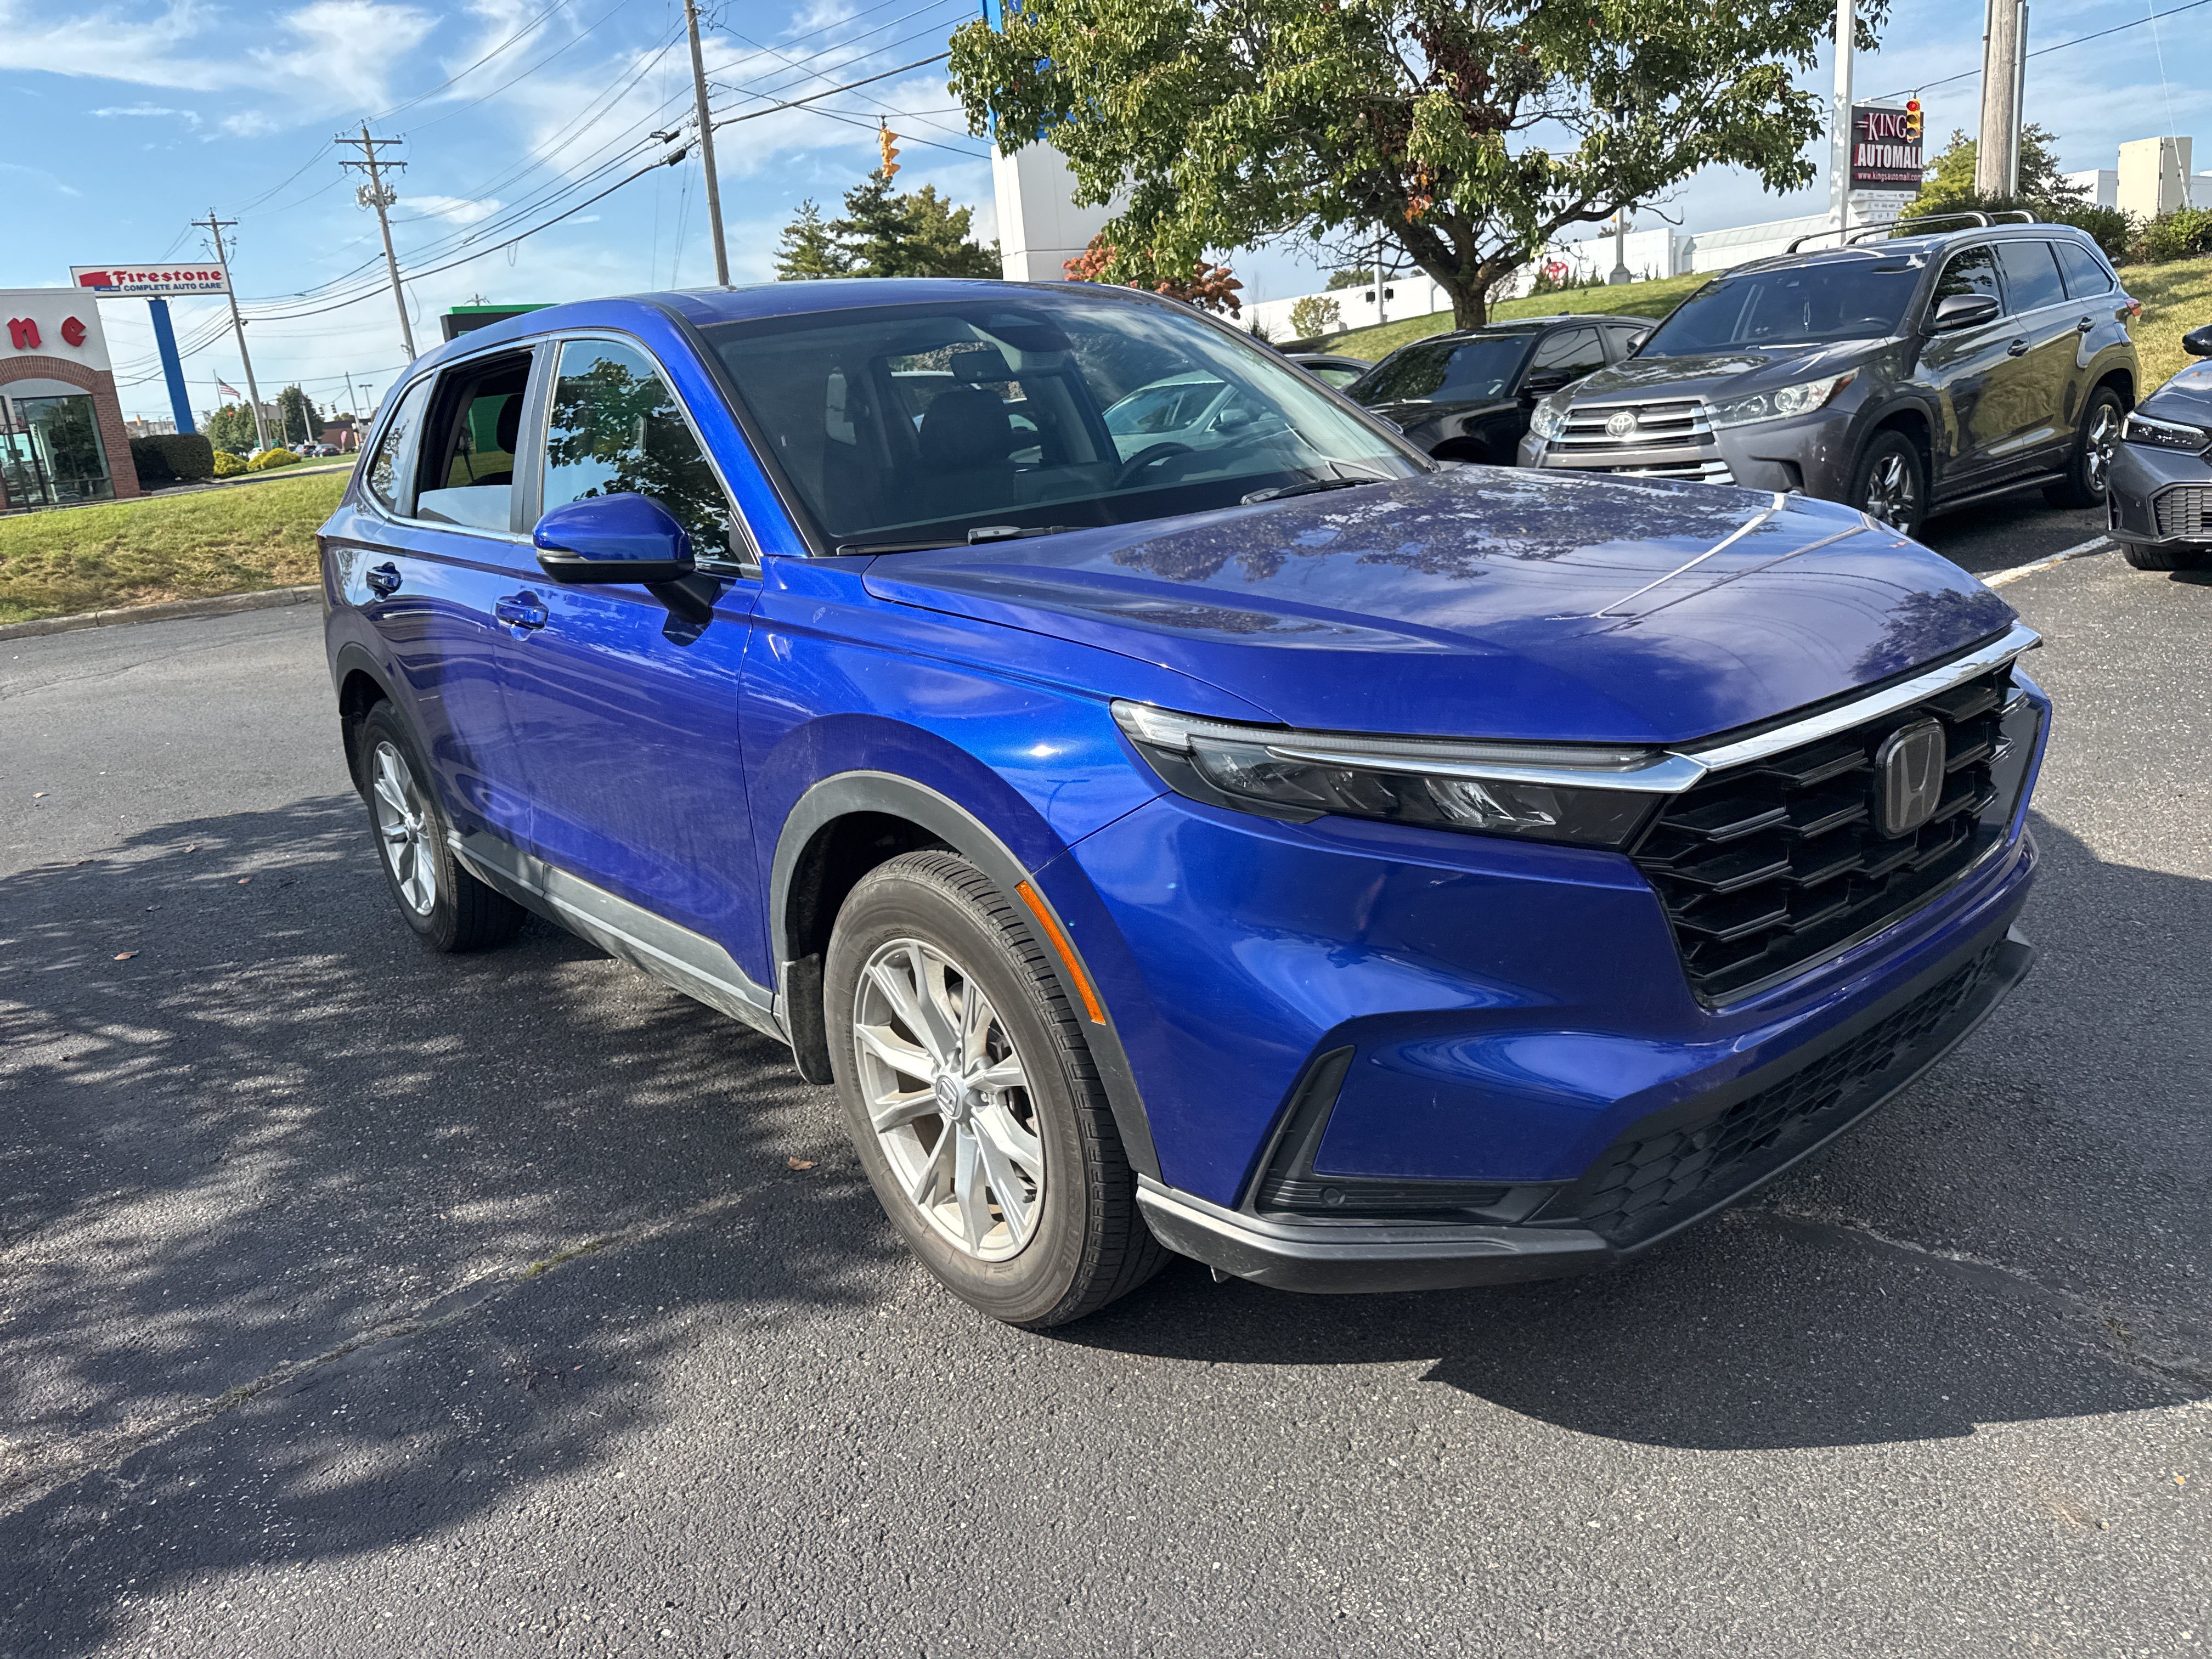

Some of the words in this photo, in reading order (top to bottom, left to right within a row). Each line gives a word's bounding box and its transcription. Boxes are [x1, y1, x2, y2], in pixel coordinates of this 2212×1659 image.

[1867, 112, 1914, 143] KING
[1857, 143, 1923, 168] AUTOMALL
[112, 270, 222, 286] Firestone
